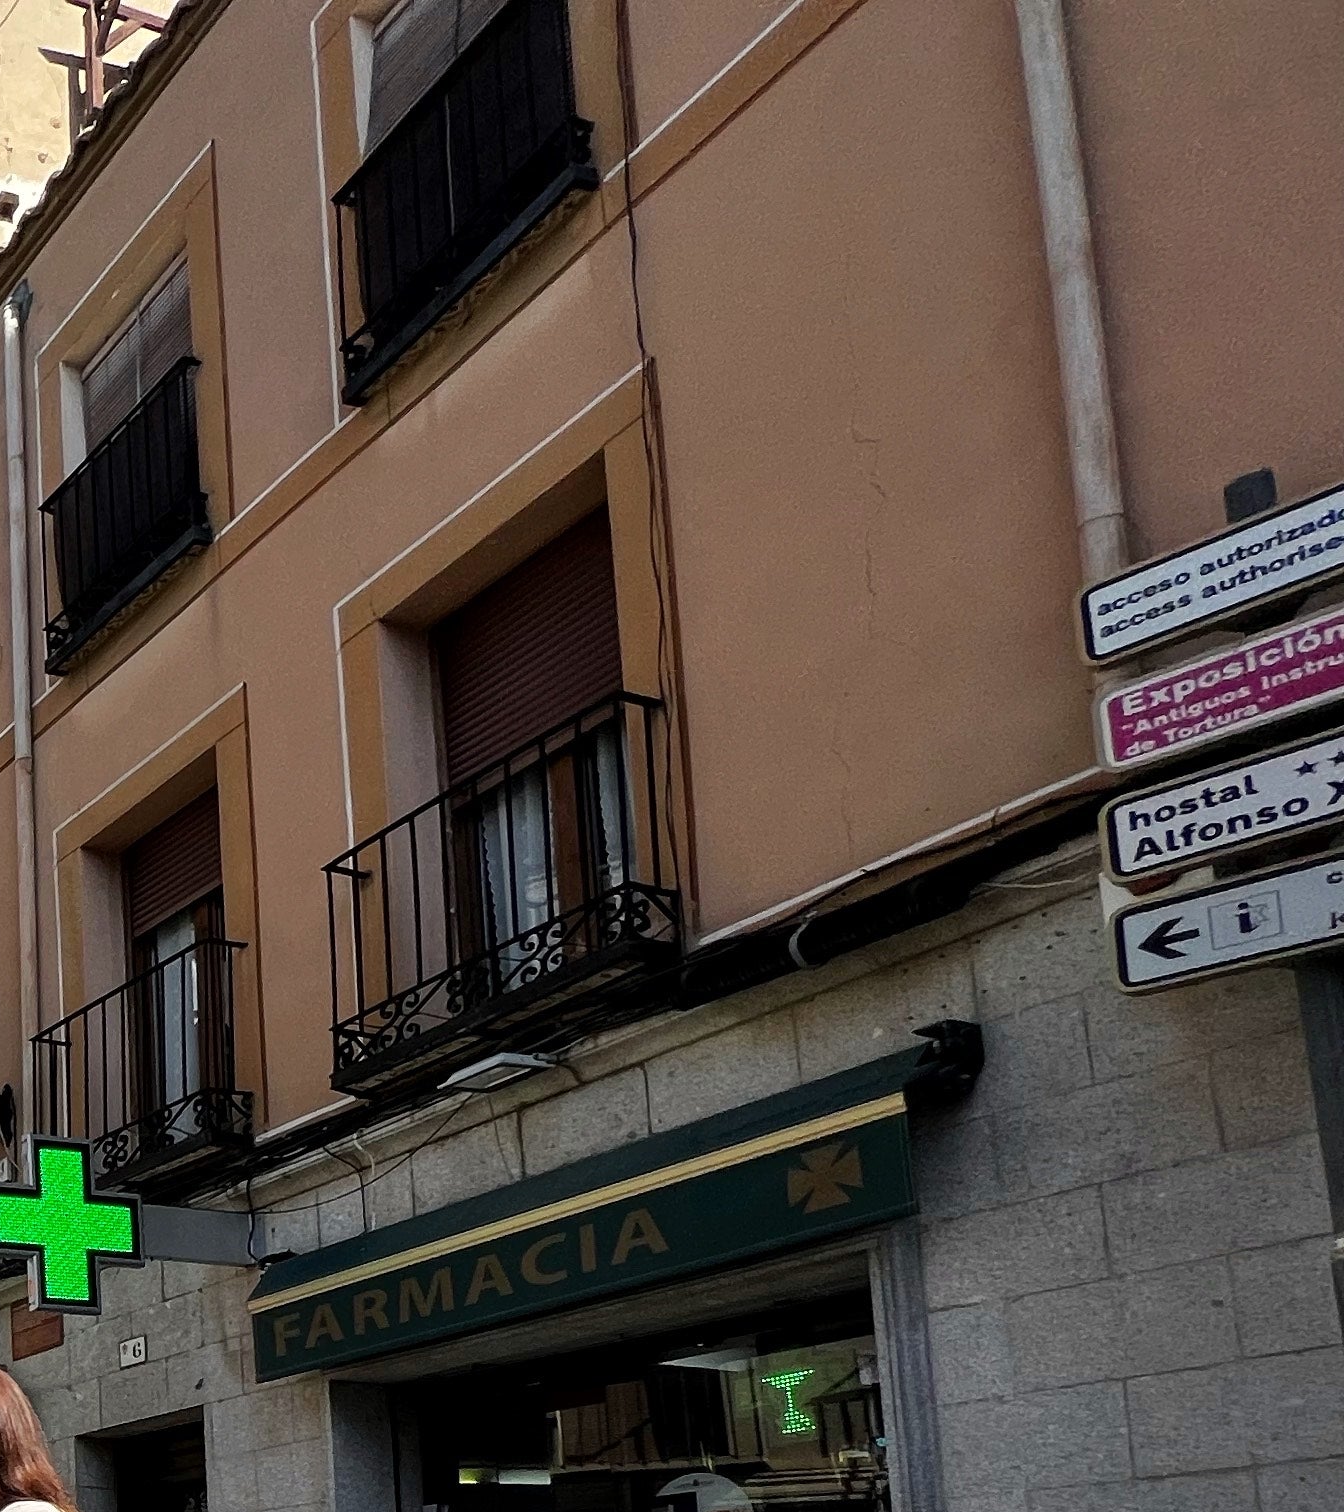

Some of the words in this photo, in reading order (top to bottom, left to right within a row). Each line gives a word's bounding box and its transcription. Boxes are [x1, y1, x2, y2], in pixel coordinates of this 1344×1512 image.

[1098, 571, 1190, 616] acceso
[1100, 594, 1193, 638] access
[1122, 623, 1344, 716] Exposición
[1125, 739, 1157, 756] de
[1129, 775, 1260, 831] hostal
[1133, 797, 1310, 863] Alfonso
[272, 1207, 670, 1358] FARMACIA
[133, 1341, 142, 1358] 6
